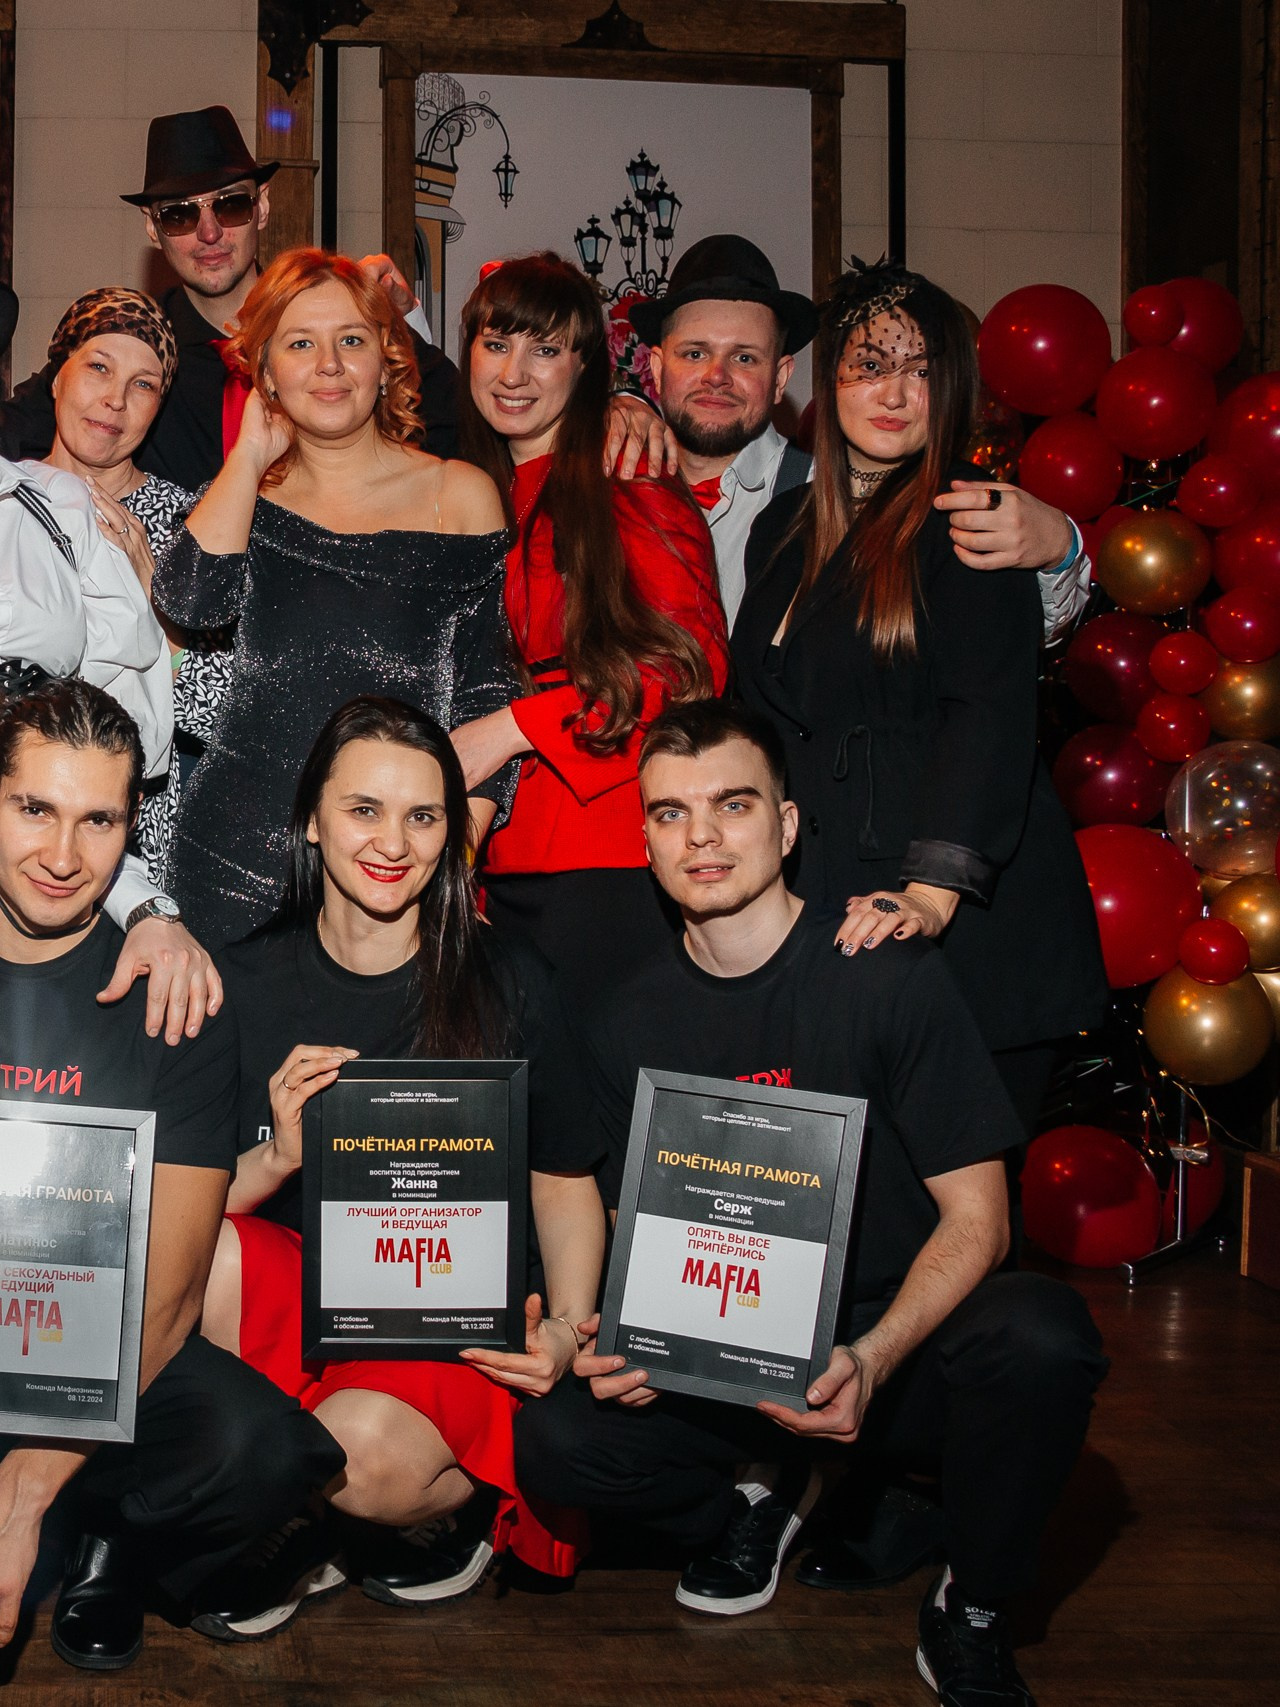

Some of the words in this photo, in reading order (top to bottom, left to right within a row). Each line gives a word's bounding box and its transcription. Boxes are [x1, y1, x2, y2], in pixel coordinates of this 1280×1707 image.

[702, 1115, 726, 1123] которые
[722, 1111, 747, 1120] Спасибо
[333, 1136, 416, 1152] ПОЧЁТНАЯ
[420, 1138, 495, 1152] ГРАМОТА
[389, 1161, 440, 1170] Награждается
[657, 1150, 742, 1176] ПОЧЁТНАЯ
[744, 1164, 822, 1189] ГРАМОТА
[369, 1169, 402, 1177] воспитка
[402, 1169, 416, 1177] под
[416, 1169, 460, 1178] прикрытием
[391, 1177, 438, 1189] Жанна
[36, 1185, 114, 1204] ГРАМОТА
[684, 1184, 735, 1199] Награждается
[735, 1193, 786, 1207] ясно-ведущий
[346, 1205, 397, 1217] ЛУЧШИЙ
[400, 1207, 482, 1217] ОРГАНИЗАТОР
[713, 1198, 753, 1216] Серж
[381, 1219, 389, 1229] И
[392, 1219, 448, 1231] ВЕДУЩАЯ
[714, 1214, 754, 1226] номинации
[687, 1226, 725, 1241] ОПЯТЬ
[727, 1233, 746, 1245] ВЫ
[748, 1236, 771, 1249] ВСЕ
[687, 1238, 766, 1261] ПРИПЁРЛИСЬ
[374, 1238, 452, 1288] MAFIA
[429, 1263, 452, 1275] CLUB
[3, 1266, 95, 1283] СЕКСУАЛЬНЫЙ
[681, 1257, 761, 1318] MAFIA
[736, 1294, 760, 1309] CLUB
[635, 1335, 666, 1347] любовью
[633, 1343, 670, 1356] обожанием
[719, 1352, 749, 1363] Команда
[749, 1357, 795, 1372] Мафиозников
[758, 1367, 794, 1380] 08.12.2024
[25, 1383, 56, 1393] Команда
[56, 1385, 104, 1396] Мафиозников
[67, 1394, 103, 1404] 08.12.2024
